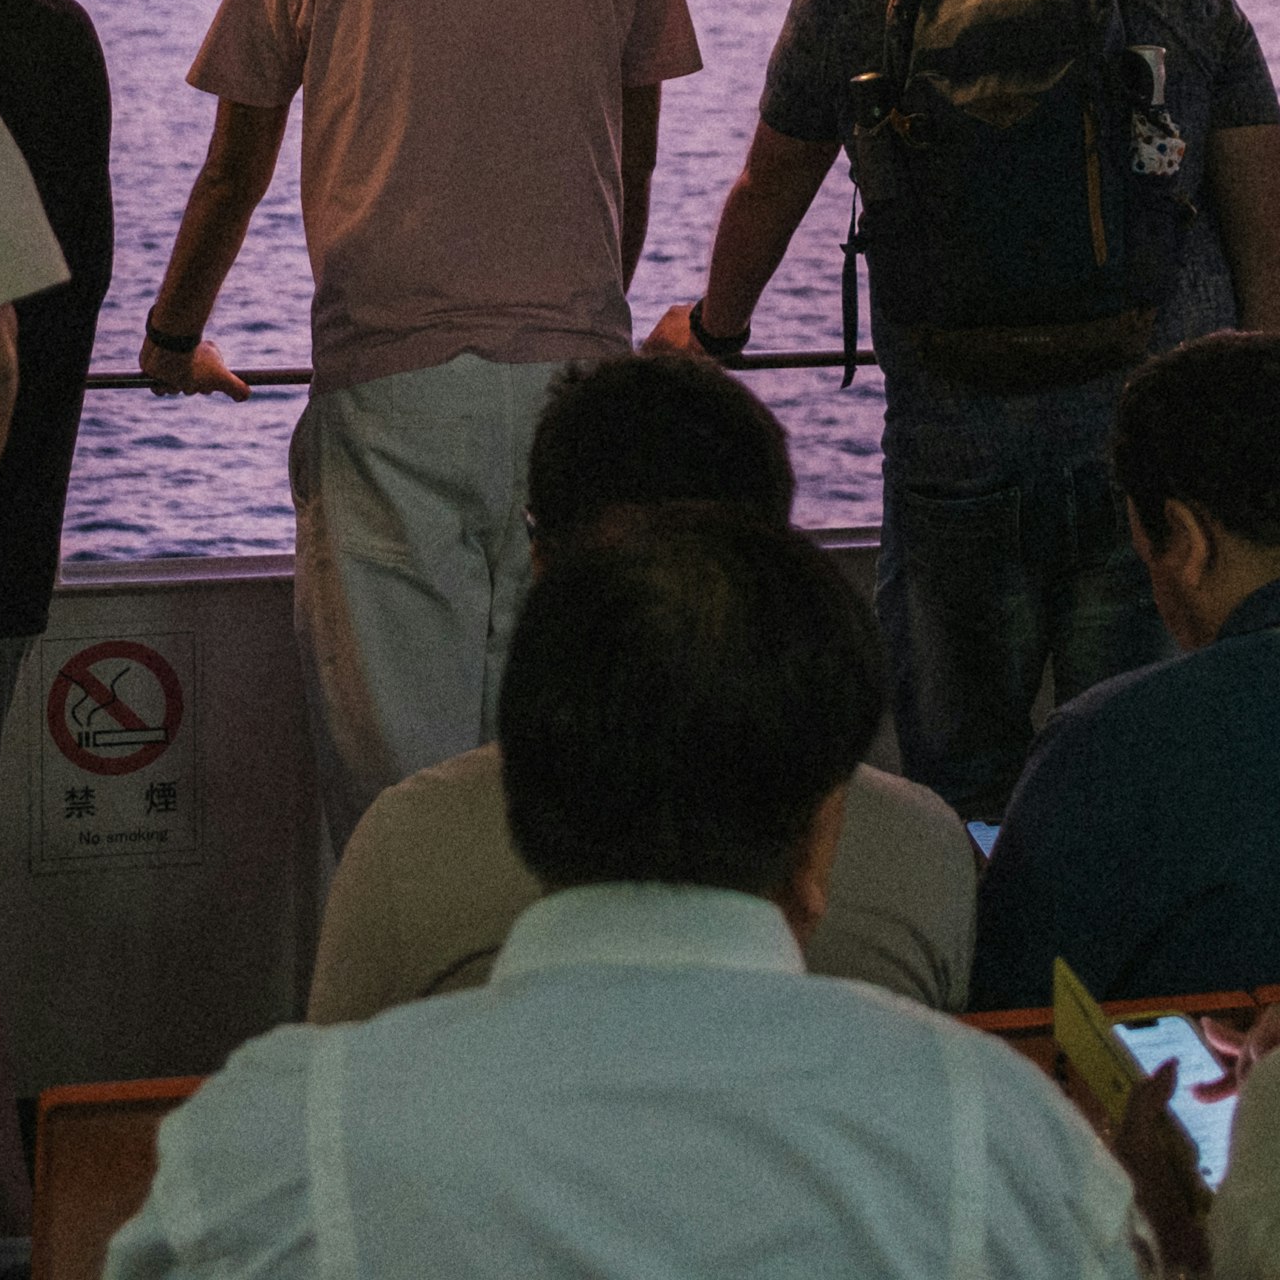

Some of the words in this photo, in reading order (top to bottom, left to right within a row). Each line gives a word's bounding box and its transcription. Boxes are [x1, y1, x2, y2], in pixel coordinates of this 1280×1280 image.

[65, 782, 177, 818] 禁煙
[79, 831, 100, 845] No
[106, 829, 168, 843] smoking
